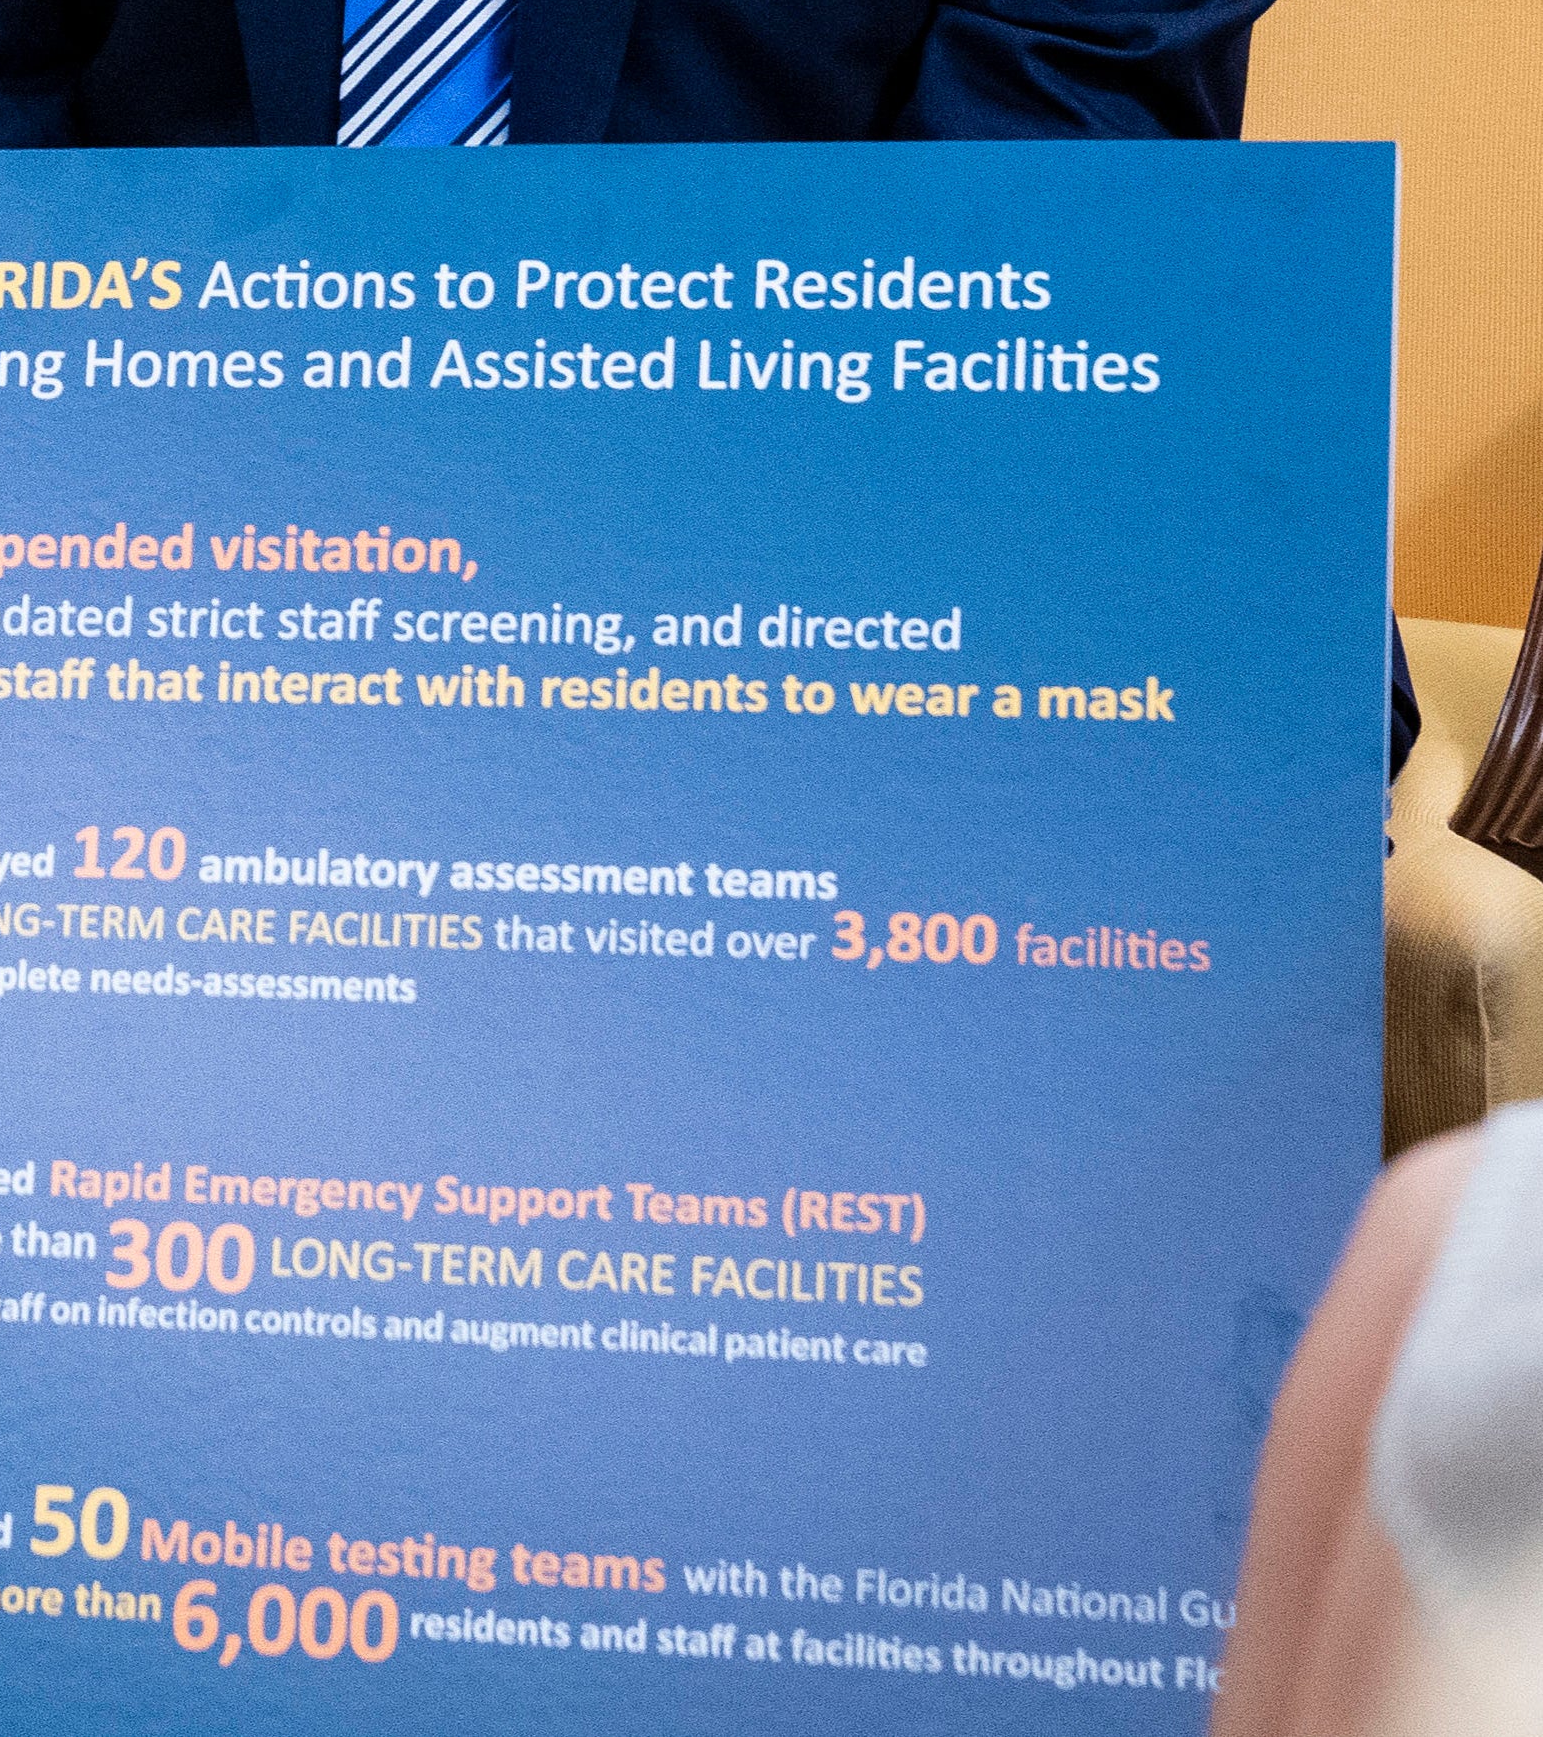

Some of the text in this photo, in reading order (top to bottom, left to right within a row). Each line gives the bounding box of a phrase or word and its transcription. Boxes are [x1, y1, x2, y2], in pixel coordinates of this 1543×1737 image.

[198, 258, 417, 310] Actions
[433, 263, 496, 311] to
[516, 258, 735, 311] Protect
[754, 255, 1052, 311] Residents
[85, 339, 285, 389] Homes
[302, 335, 412, 390] and
[429, 335, 676, 391] Assisted
[697, 338, 873, 405] Living
[892, 336, 1161, 394] Facilities
[210, 524, 479, 583] visitation,
[148, 598, 264, 639] strict
[279, 598, 382, 640] staff
[394, 602, 636, 655] screening,
[652, 603, 743, 647] and
[758, 603, 963, 652] directed
[106, 658, 204, 702] that
[218, 661, 403, 706] interact
[416, 664, 525, 708] with
[541, 666, 769, 714] residents
[781, 674, 836, 715] to
[849, 682, 981, 718] wear
[991, 683, 1023, 719] a
[1037, 675, 1176, 722] mask
[74, 825, 186, 881] 120
[200, 847, 439, 897] ambulatory
[450, 861, 694, 896] assessment
[704, 863, 838, 901] teams
[177, 908, 275, 943] CARE
[290, 911, 482, 950] FACILITIES
[495, 916, 573, 952] that
[586, 920, 714, 957] visited
[727, 931, 816, 960] over
[831, 909, 999, 970] 3,800
[1015, 922, 1211, 972] facilities
[91, 965, 416, 1003] needs-assessments
[51, 1160, 171, 1207] Rapid
[185, 1165, 423, 1221] Emergency
[435, 1175, 613, 1226] Support
[625, 1183, 768, 1228] Teams
[782, 1187, 926, 1243] (REST)
[12, 1222, 95, 1257] than
[106, 1219, 254, 1294] 300
[272, 1238, 542, 1287] LONG-TERM
[558, 1250, 674, 1295] CARE
[692, 1256, 924, 1307] FACILITIES
[50, 1301, 90, 1324] on
[98, 1296, 238, 1331] infection
[245, 1308, 377, 1338] controls
[384, 1312, 443, 1341] and
[451, 1320, 593, 1351] augment
[601, 1320, 717, 1355] clinical
[725, 1328, 845, 1362] patient
[853, 1340, 927, 1366] care
[30, 1484, 130, 1560] 50
[141, 1518, 313, 1571] Mobile
[327, 1532, 497, 1592] testing
[510, 1543, 666, 1593] teams
[684, 1561, 767, 1596] with
[780, 1564, 842, 1601] the
[857, 1569, 987, 1610] Florida
[1003, 1579, 1166, 1621] National
[74, 1581, 162, 1622] than
[172, 1579, 399, 1668] 6,000
[411, 1609, 571, 1648] residents
[580, 1619, 647, 1652] and
[657, 1624, 736, 1658] staff
[745, 1632, 780, 1661] at
[791, 1629, 942, 1672] facilities
[953, 1642, 1162, 1688] throughout
